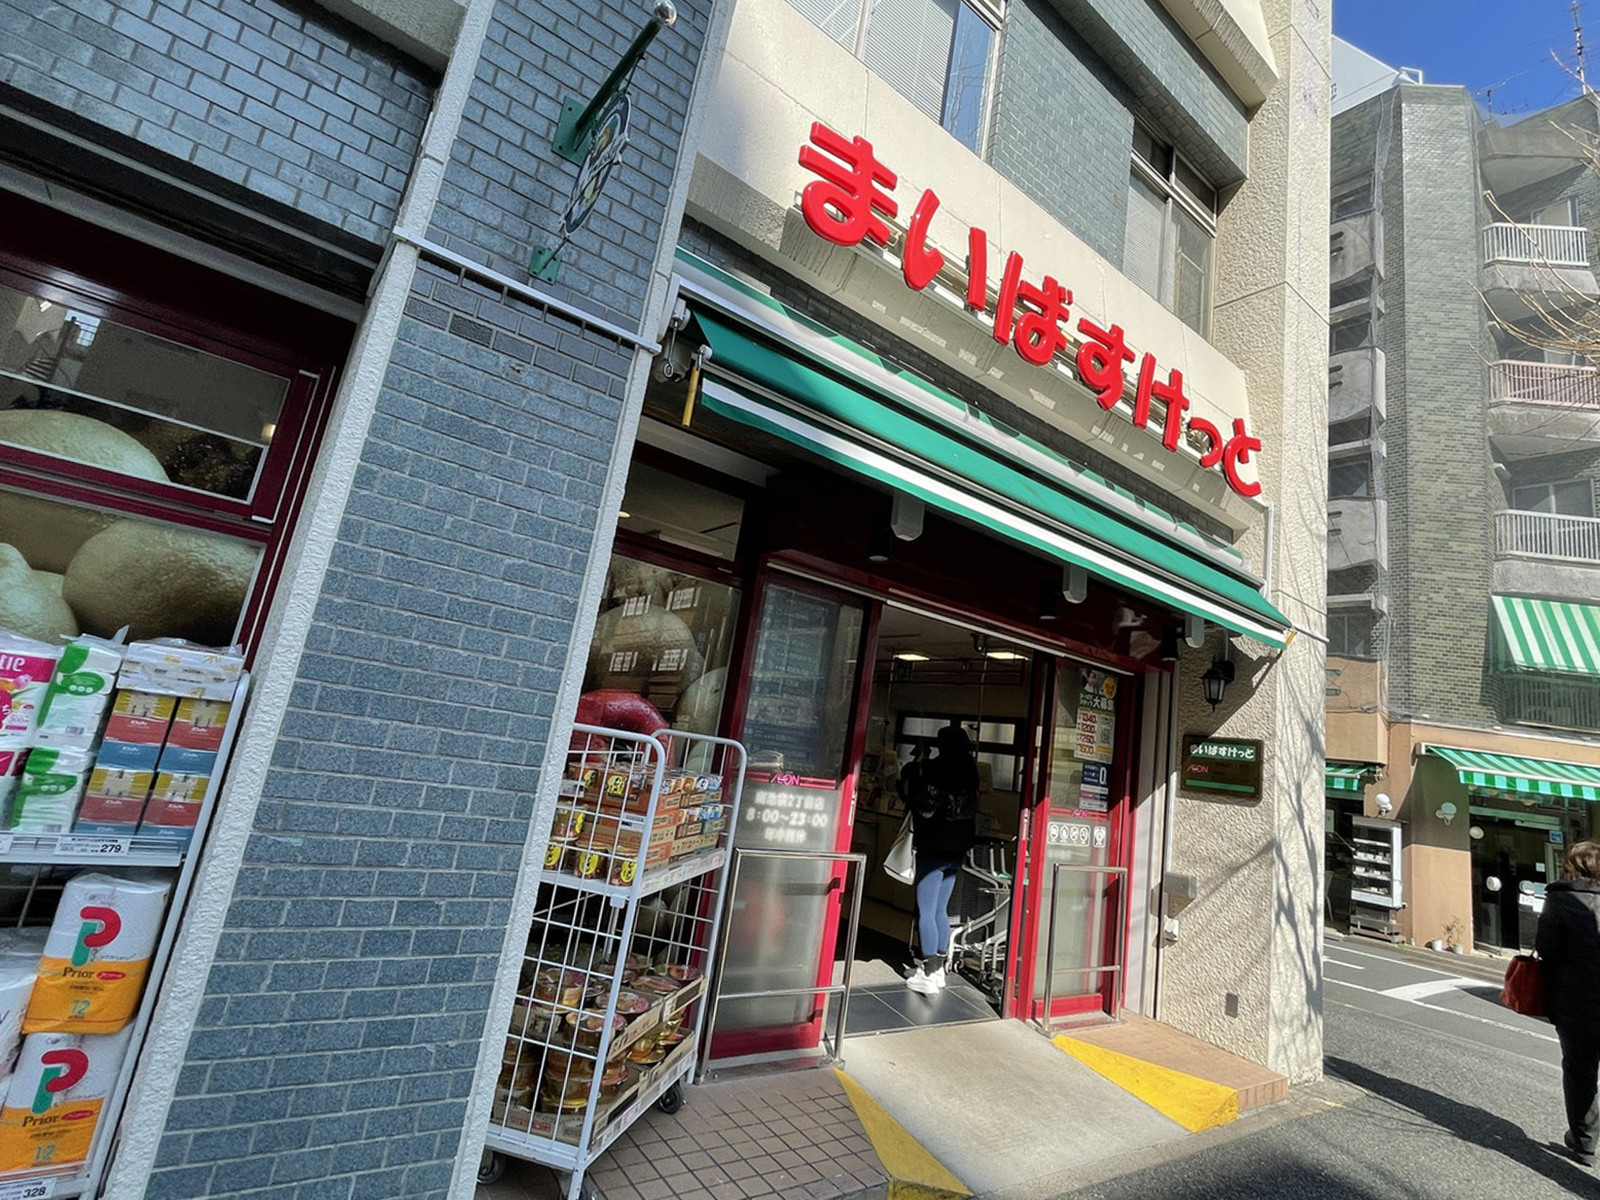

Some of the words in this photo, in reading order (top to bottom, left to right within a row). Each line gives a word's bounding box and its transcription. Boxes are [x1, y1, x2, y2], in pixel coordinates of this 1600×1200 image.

[799, 121, 1261, 497] まいばすけっと
[771, 773, 800, 786] AEON
[100, 843, 122, 854] 279
[63, 966, 95, 979] Prior
[22, 1115, 60, 1127] Prior
[22, 1186, 47, 1199] 328
